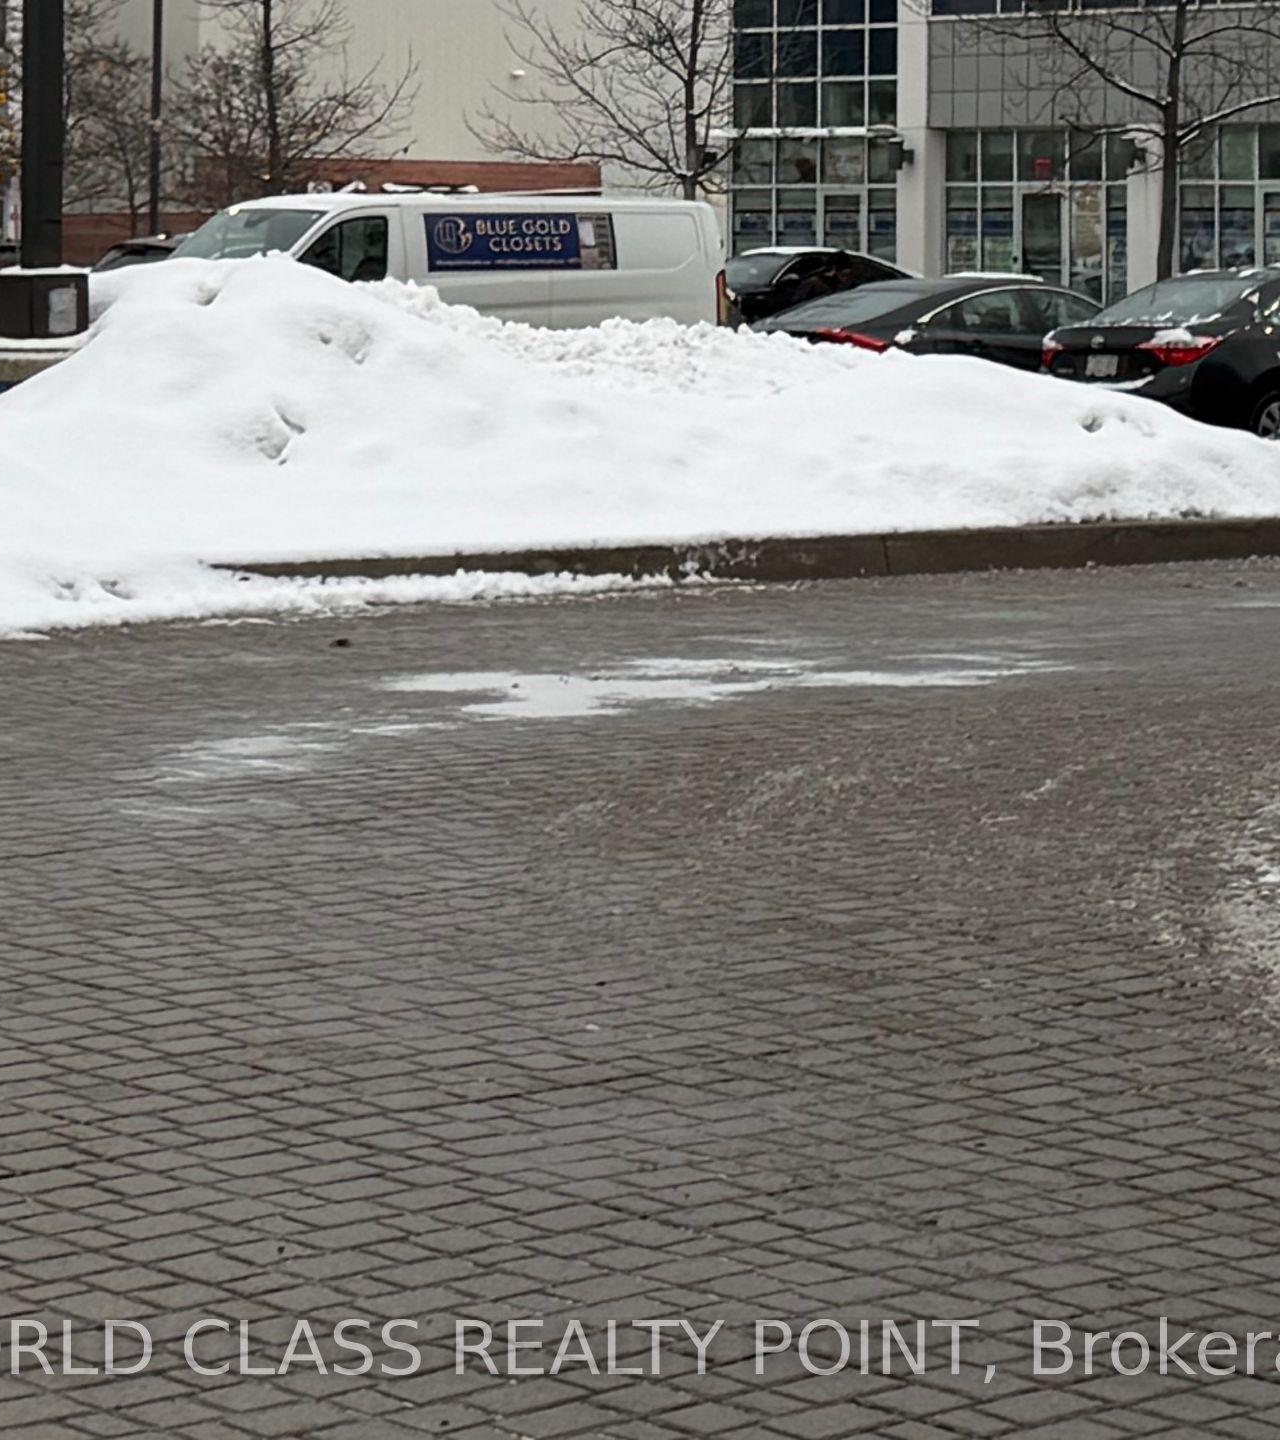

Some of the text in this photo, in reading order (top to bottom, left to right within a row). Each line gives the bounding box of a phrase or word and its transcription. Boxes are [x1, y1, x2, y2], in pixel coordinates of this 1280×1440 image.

[475, 219, 570, 235] BLUE GOLD
[489, 237, 562, 252] CLOSETS
